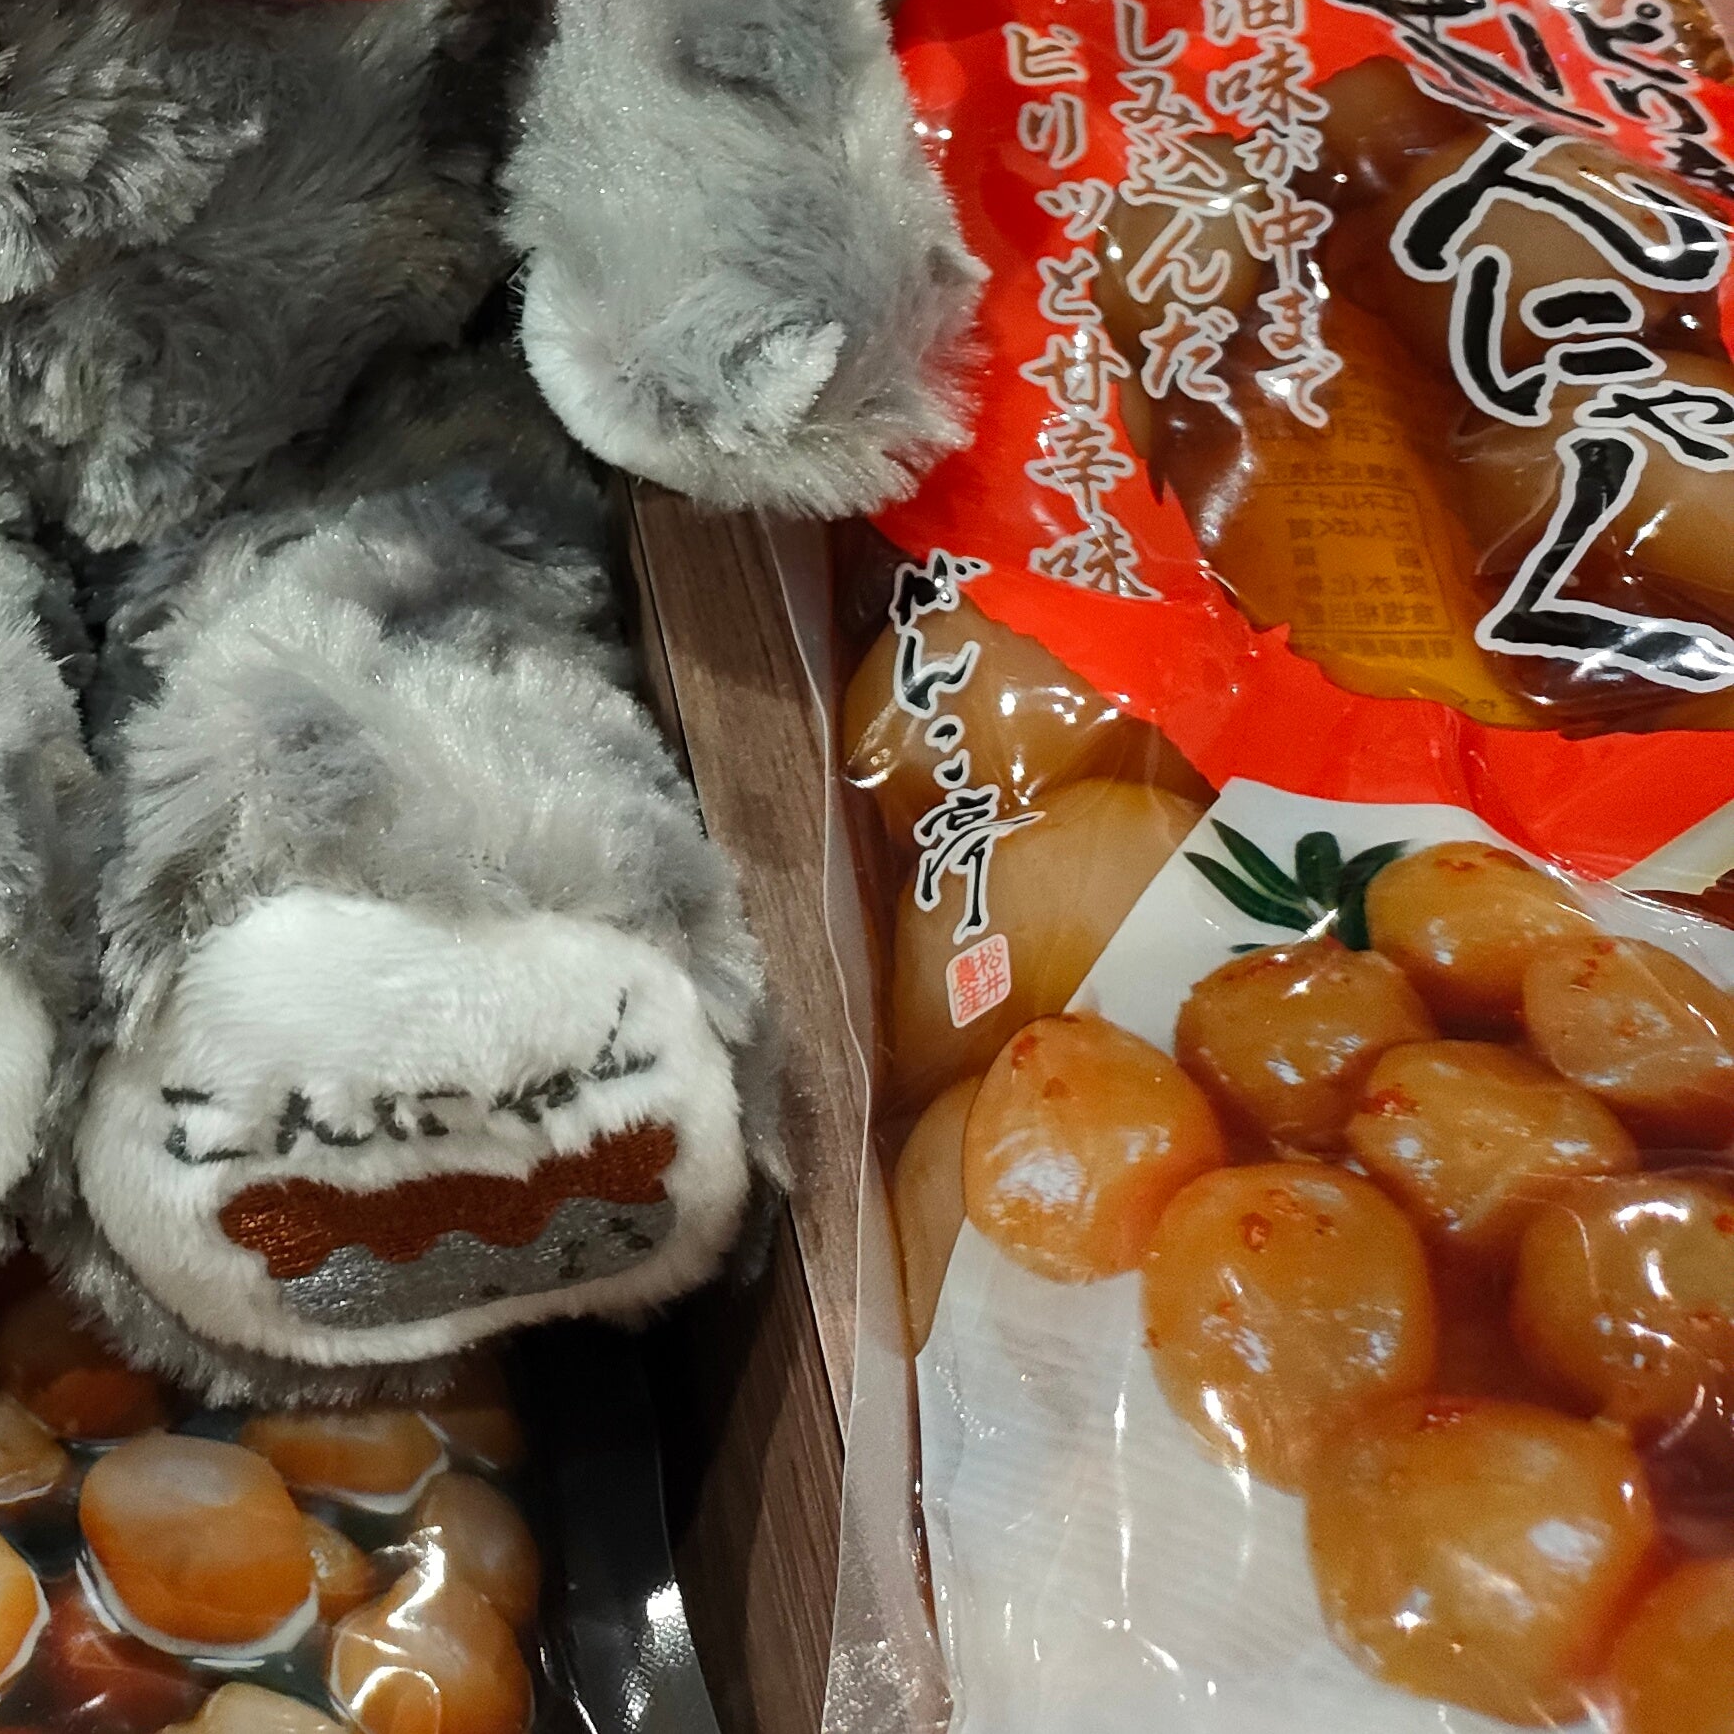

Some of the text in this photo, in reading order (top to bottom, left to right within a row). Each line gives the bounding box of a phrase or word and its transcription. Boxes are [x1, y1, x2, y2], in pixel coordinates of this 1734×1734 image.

[1118, 0, 1234, 396] しみ込んだ
